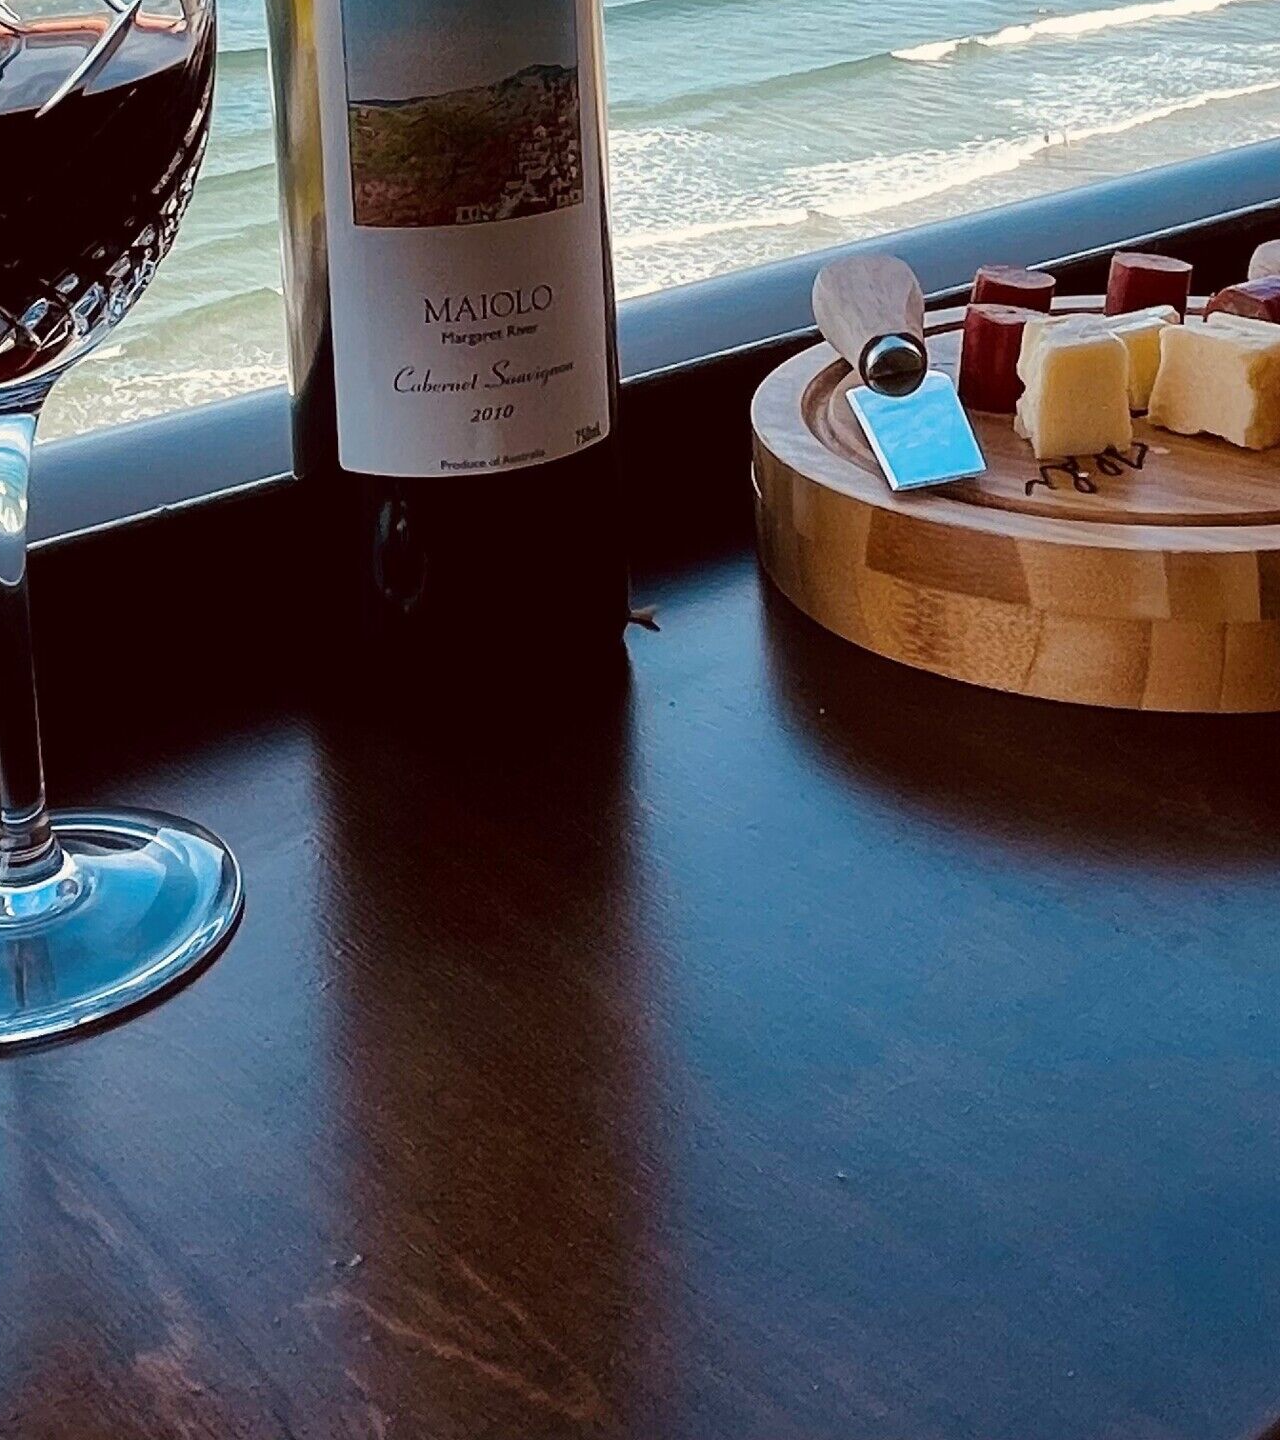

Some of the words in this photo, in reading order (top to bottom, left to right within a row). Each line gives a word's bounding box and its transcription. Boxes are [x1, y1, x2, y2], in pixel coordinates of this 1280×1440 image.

[423, 284, 553, 324] MAIOLO
[440, 328, 503, 347] Margaret
[506, 323, 538, 338] River
[393, 366, 479, 394] Cabernet
[484, 359, 574, 389] Sauvignon
[470, 404, 515, 423] 2010
[439, 458, 487, 471] Produce
[488, 455, 501, 467] of
[502, 448, 546, 465] Australia
